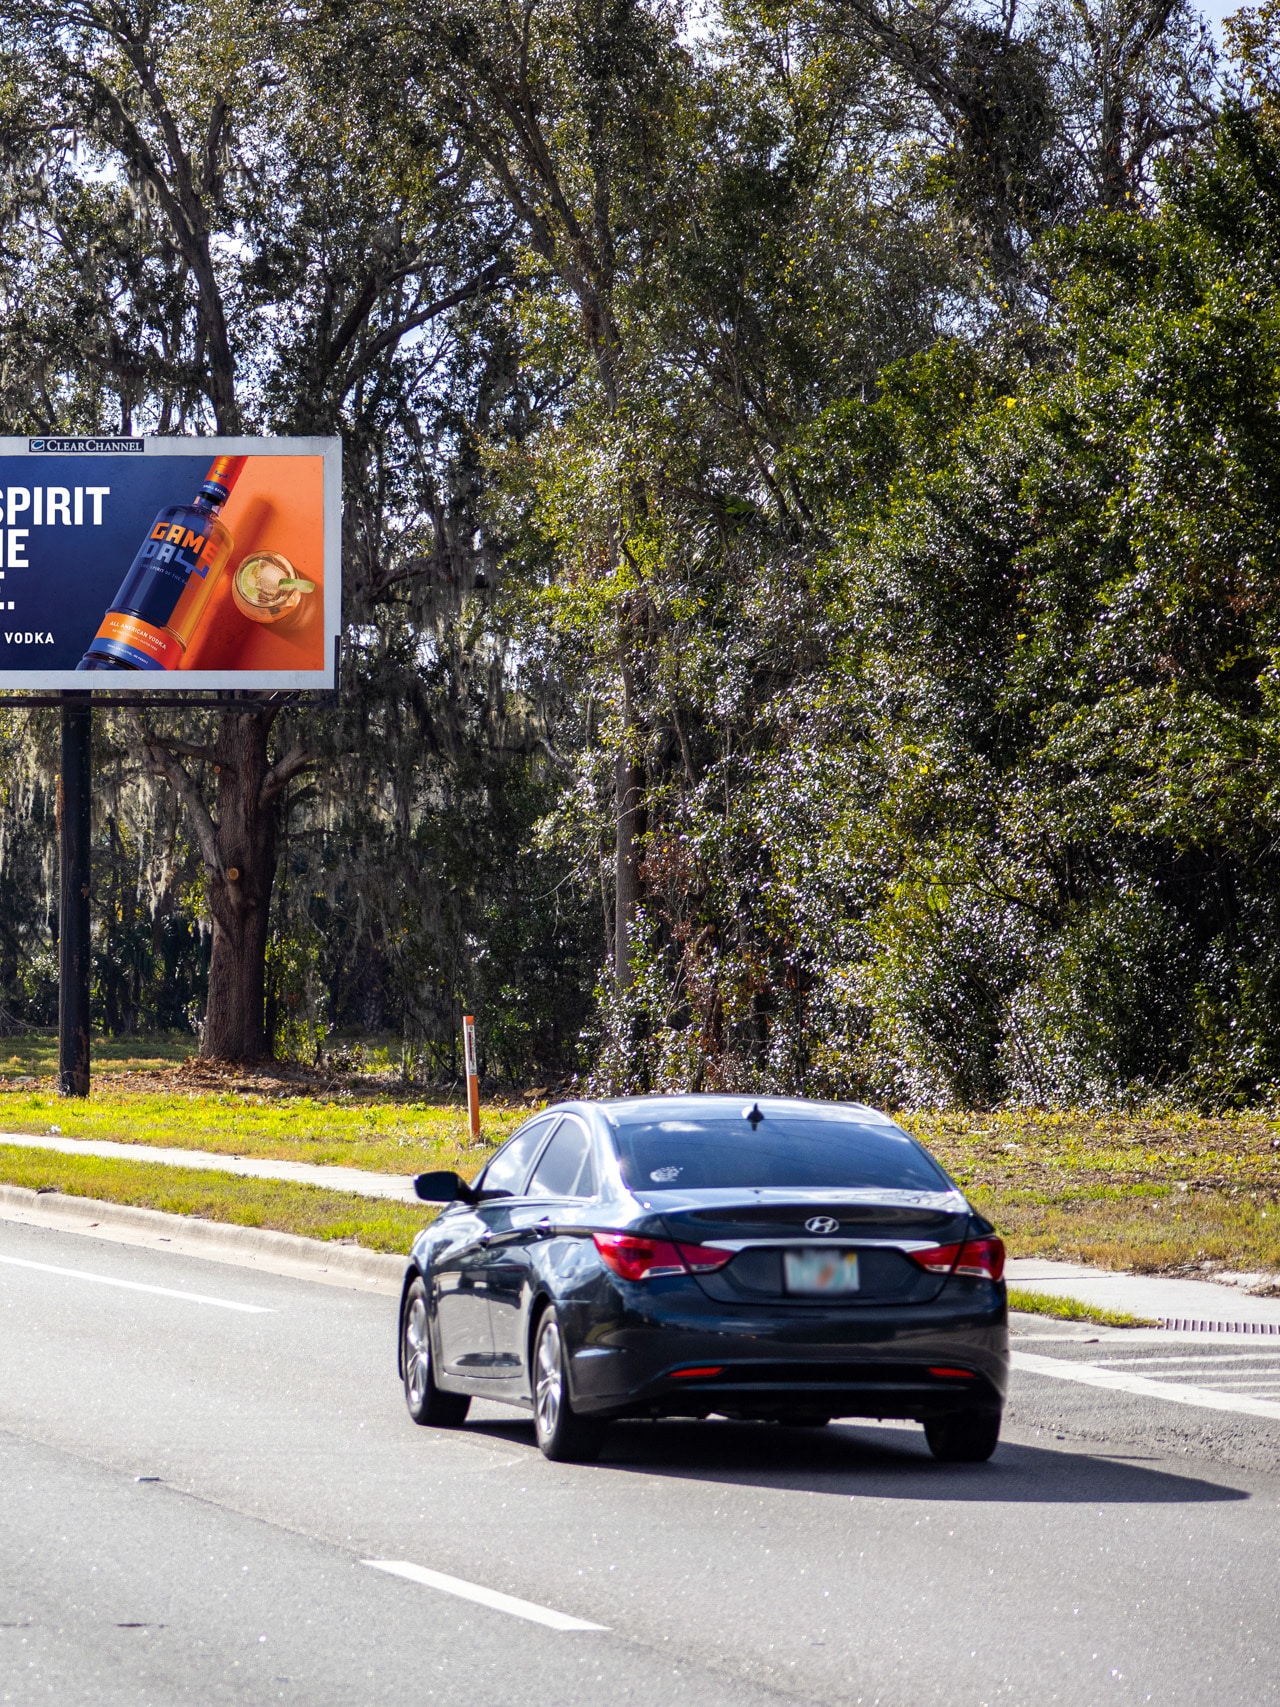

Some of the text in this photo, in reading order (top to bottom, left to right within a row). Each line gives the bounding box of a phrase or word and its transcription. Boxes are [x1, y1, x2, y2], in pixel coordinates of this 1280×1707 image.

[150, 522, 219, 565] GAME
[140, 541, 210, 579] DAY
[4, 632, 55, 644] VODKA
[121, 623, 148, 637] AMERICAN
[148, 635, 166, 650] VODKA
